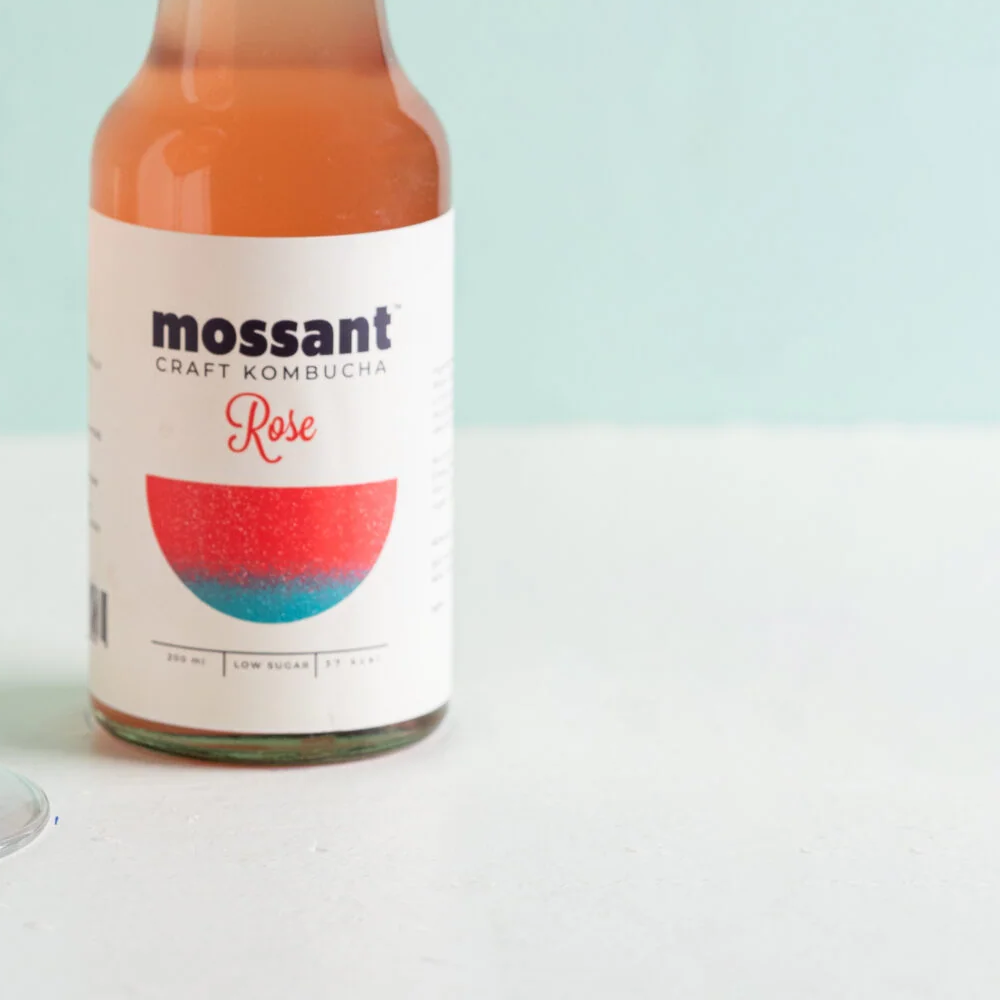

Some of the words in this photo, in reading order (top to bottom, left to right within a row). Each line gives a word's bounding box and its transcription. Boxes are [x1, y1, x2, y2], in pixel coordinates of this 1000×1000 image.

[152, 306, 392, 358] mossant
[155, 356, 231, 379] CRAFT
[243, 359, 387, 381] KOMBUCHA
[225, 392, 317, 464] Rose
[233, 660, 261, 670] LOW
[267, 660, 310, 671] SUGAR
